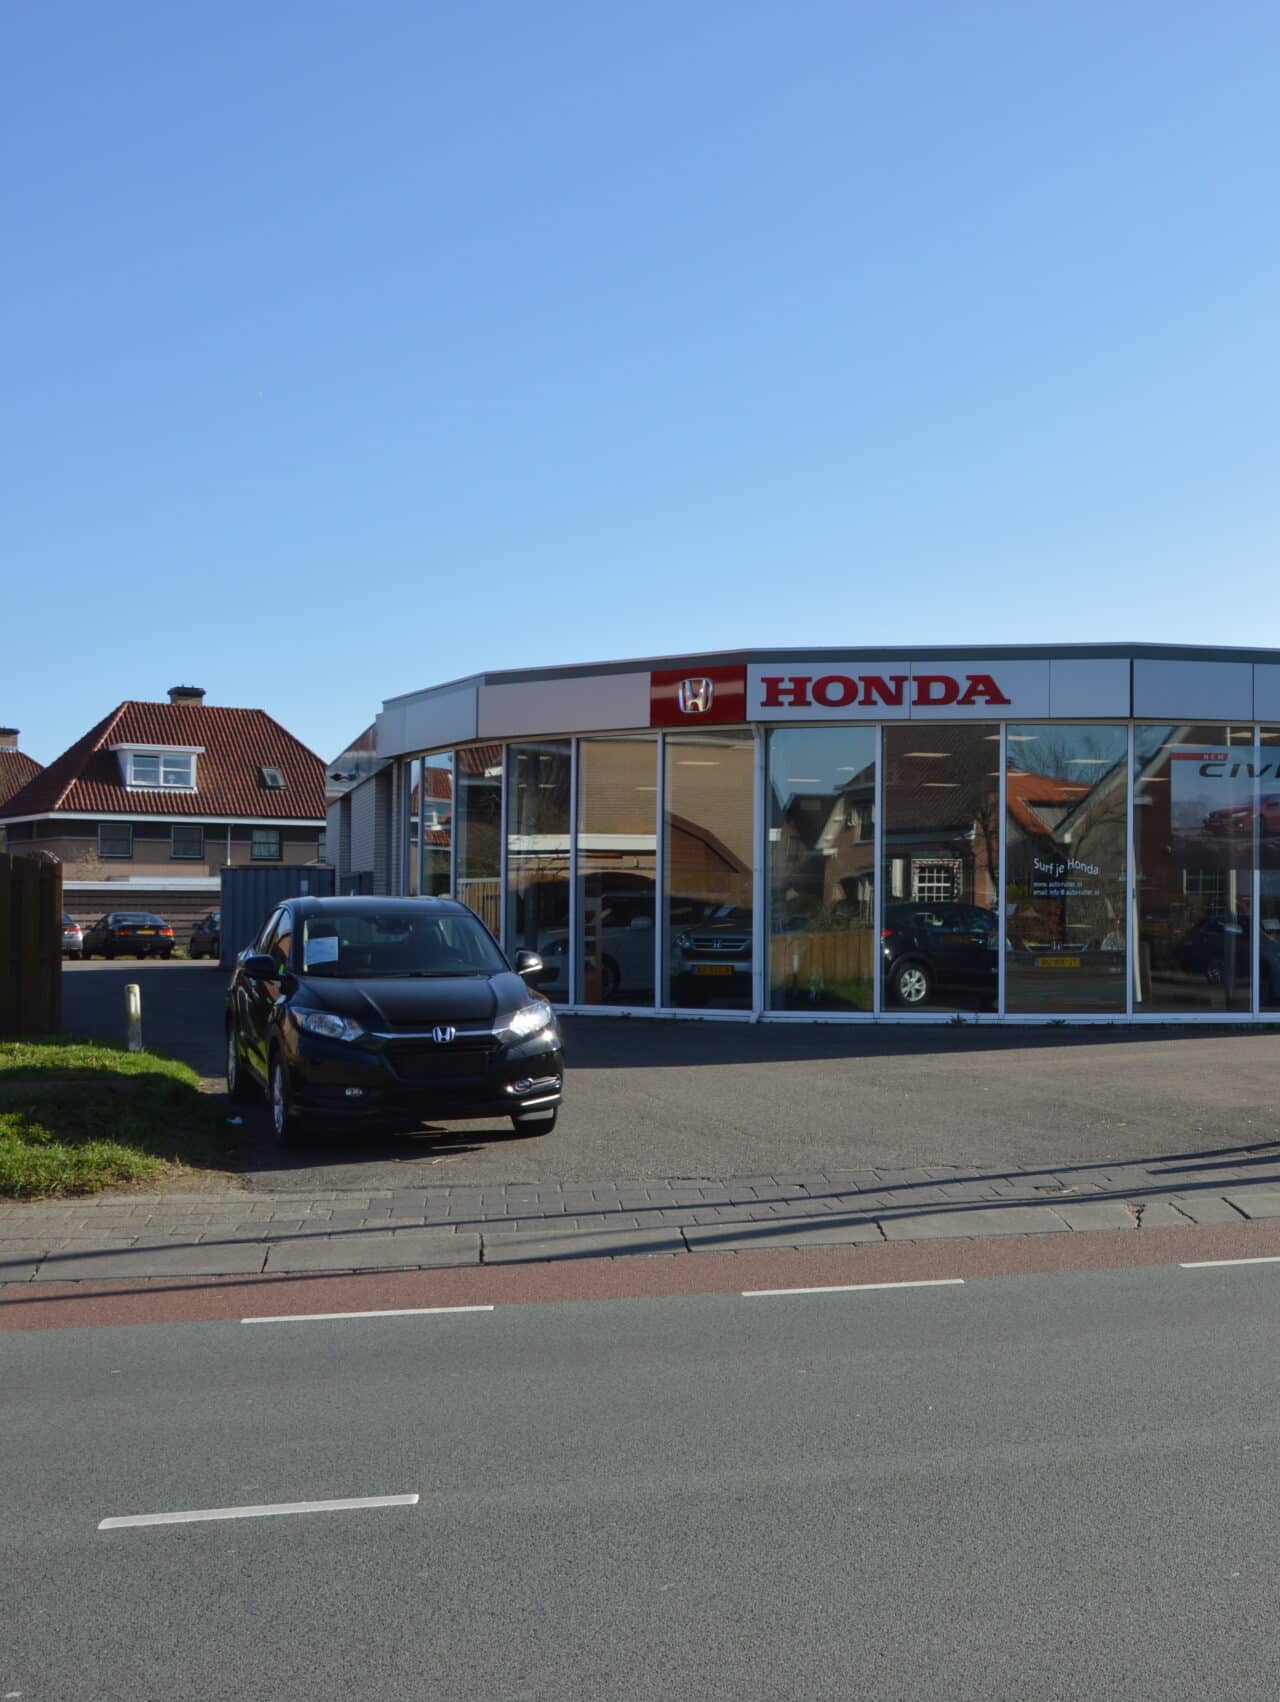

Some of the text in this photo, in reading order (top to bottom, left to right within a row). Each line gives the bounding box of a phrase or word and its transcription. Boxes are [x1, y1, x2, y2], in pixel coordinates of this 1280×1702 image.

[761, 675, 1011, 707] HONDA
[1033, 857, 1099, 877] Surf je Honda
